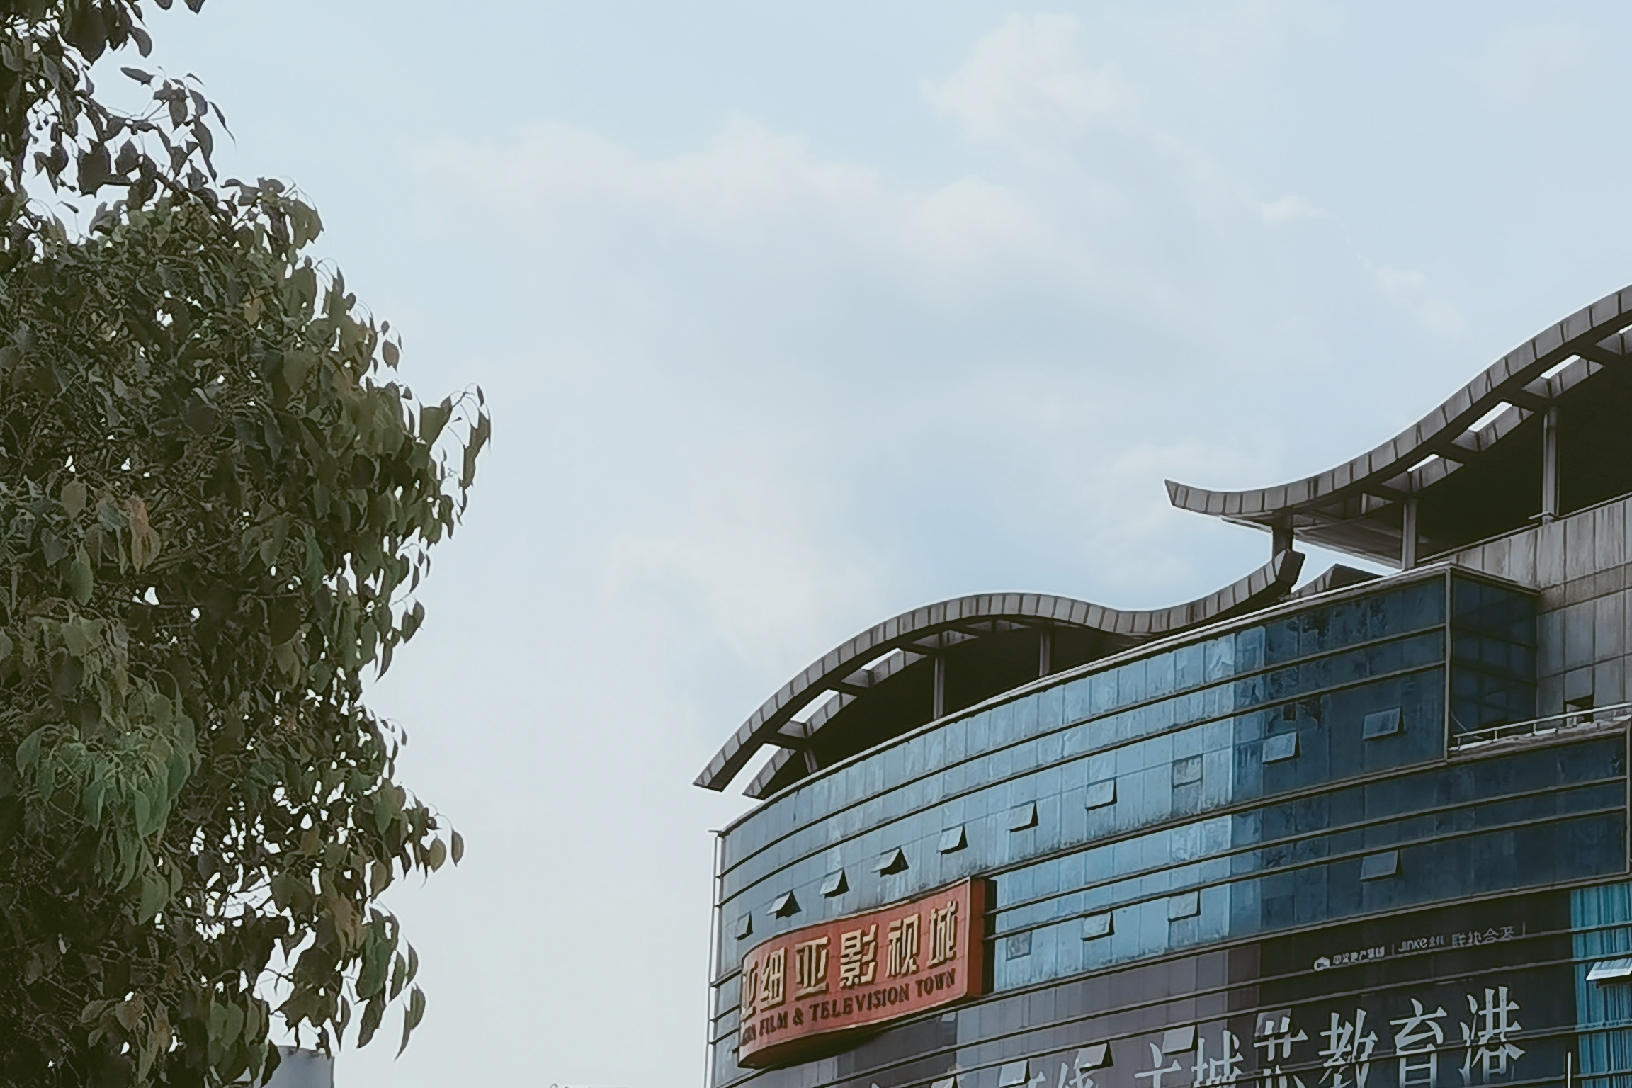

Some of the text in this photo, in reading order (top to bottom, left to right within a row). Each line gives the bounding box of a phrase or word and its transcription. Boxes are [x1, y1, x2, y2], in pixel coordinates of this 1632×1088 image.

[758, 1011, 788, 1037] FILM
[793, 1008, 804, 1027] &
[809, 982, 910, 1021] TELEVISION
[915, 967, 957, 997] TOWN
